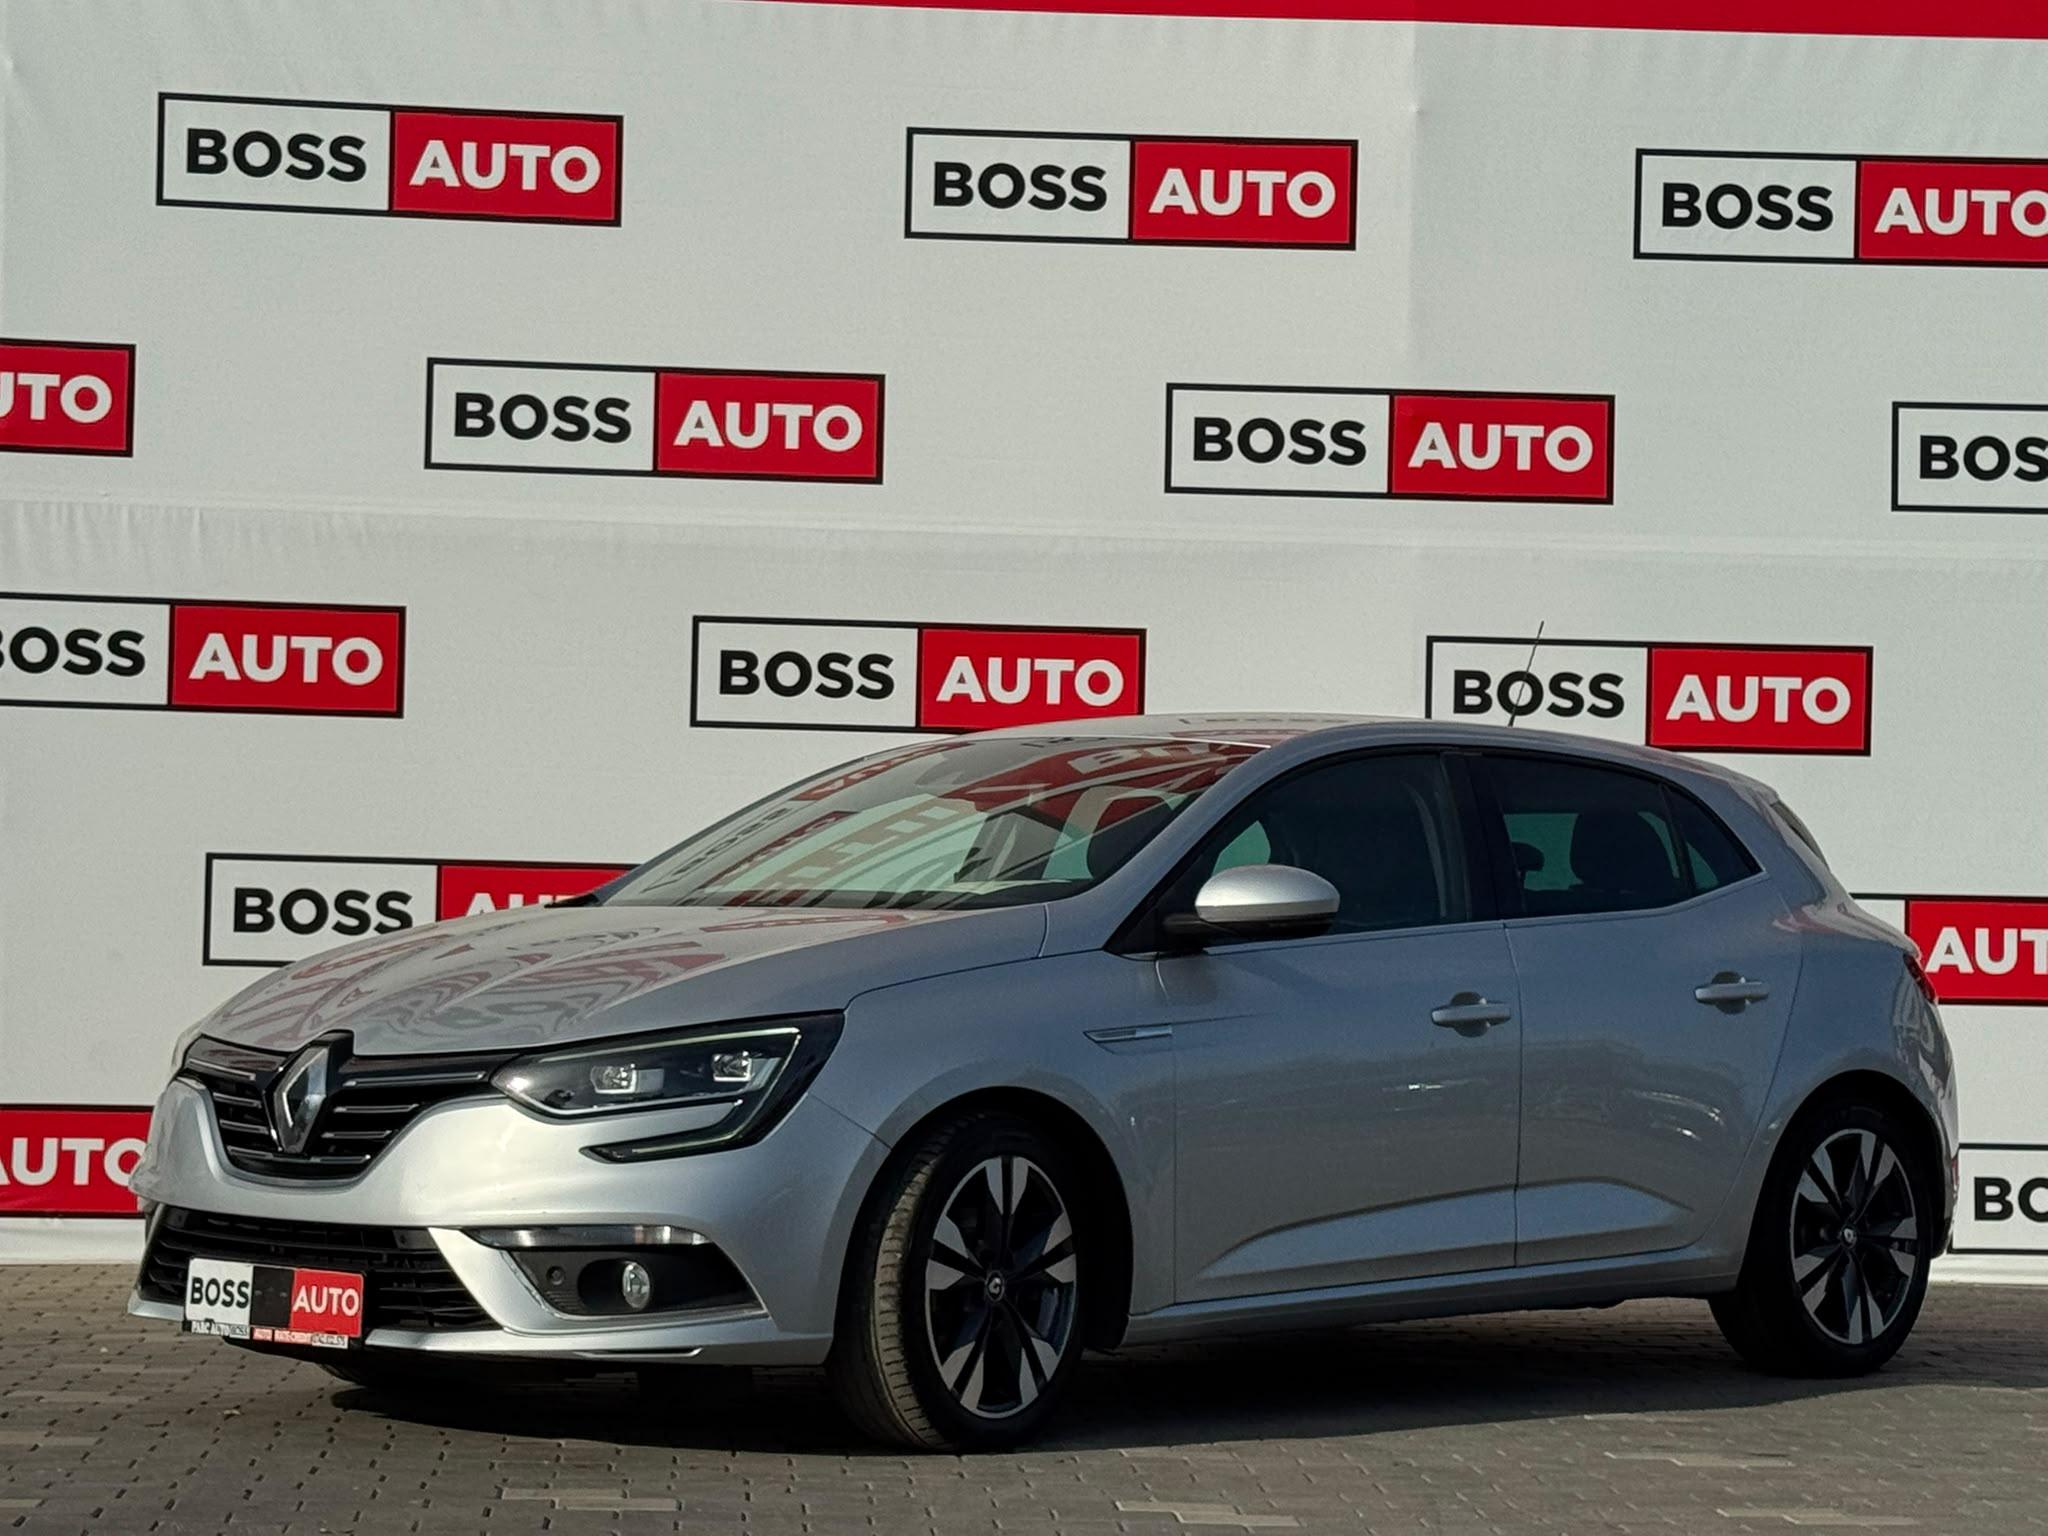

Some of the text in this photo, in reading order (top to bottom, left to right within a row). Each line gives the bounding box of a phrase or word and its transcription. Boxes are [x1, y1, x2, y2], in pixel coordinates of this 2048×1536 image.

[187, 128, 601, 194] BOSS AUTO
[934, 162, 1336, 218] BOSS AUTO
[1663, 183, 2048, 237] BOSS AUTO
[455, 393, 863, 452] BOSS AUTO
[1194, 417, 1593, 472] BOSS AUTO
[1920, 435, 2048, 482] BOS
[0, 626, 383, 685] OSS AUTO
[720, 650, 1124, 706] BOSS AUTO
[1454, 670, 1851, 724] BOSS AUTO
[234, 888, 412, 936] BOSS
[1924, 927, 2048, 975] AUT
[0, 1137, 146, 1187] UTO
[190, 1277, 360, 1317] BOSS AUTO
